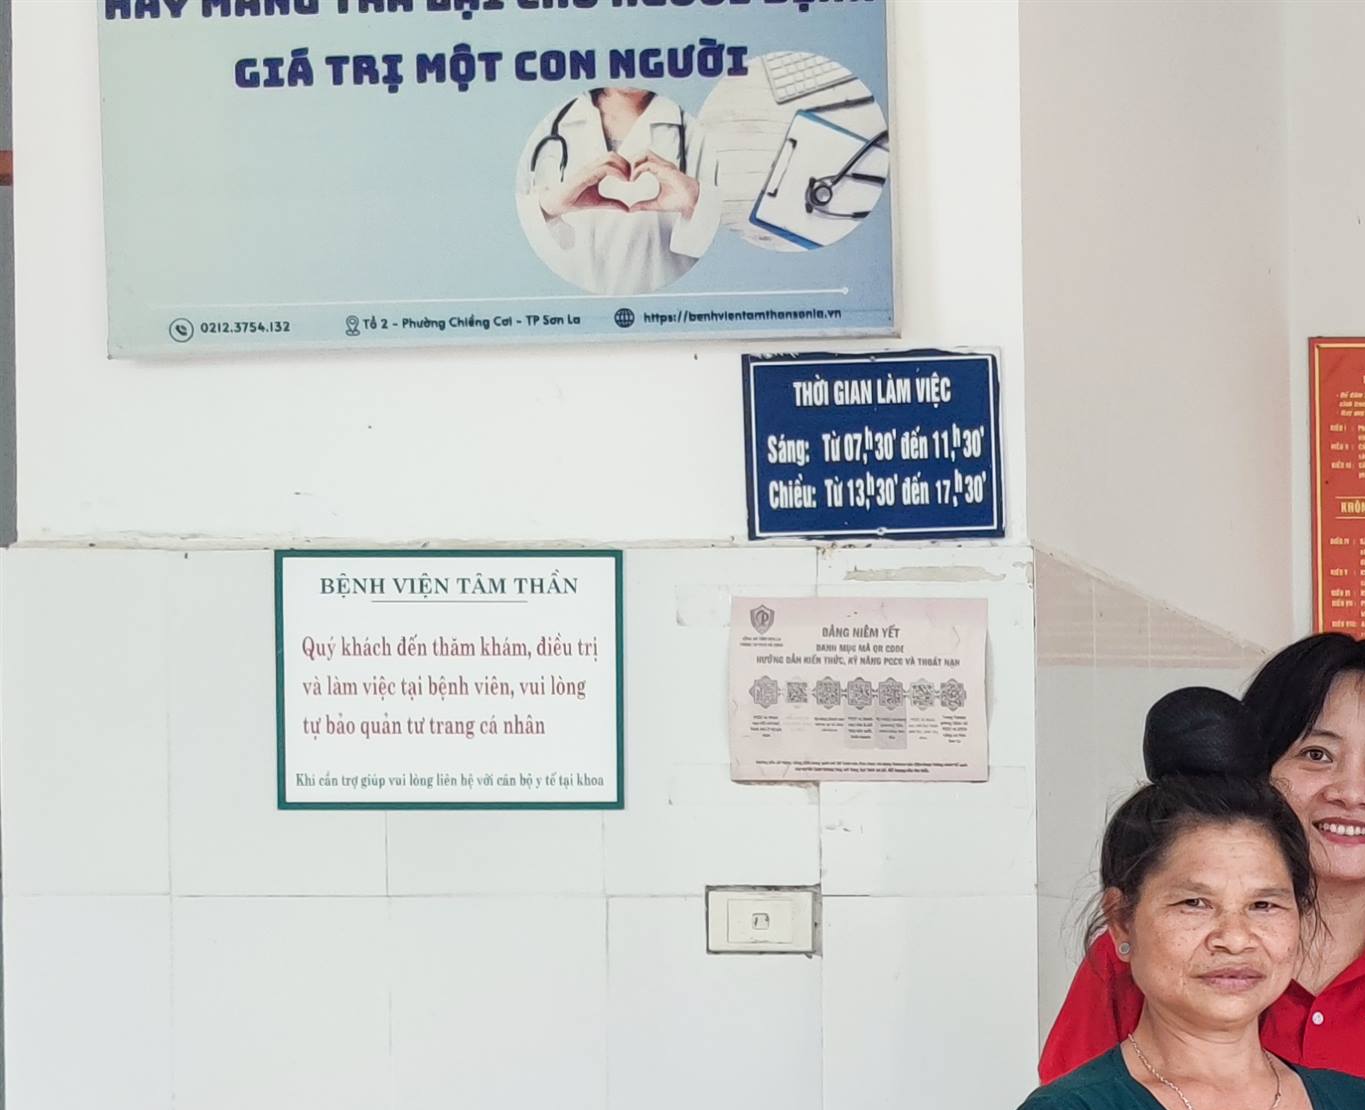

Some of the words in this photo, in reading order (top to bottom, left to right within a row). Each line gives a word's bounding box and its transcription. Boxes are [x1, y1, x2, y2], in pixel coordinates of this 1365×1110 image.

[235, 47, 313, 88] GIÁ
[325, 54, 403, 93] TRỊ
[416, 42, 502, 92] MỘT
[515, 49, 596, 81] CON
[609, 38, 748, 79] NGƯỜI
[200, 320, 291, 334] 0212.3754.132
[381, 318, 389, 329] 2
[402, 315, 446, 332] Phường
[526, 315, 540, 327] TP
[542, 314, 565, 327] Sơn
[567, 313, 581, 325] La
[793, 374, 829, 407] THỜI
[834, 378, 873, 406] GIAN
[877, 373, 911, 405] LÀM
[916, 371, 951, 408] VIỆC
[768, 429, 810, 466] Sáng:
[822, 428, 840, 462] Từ
[901, 426, 929, 460] đến
[769, 473, 817, 509] Chiều:
[825, 475, 843, 507] Từ
[902, 472, 929, 505] đến
[320, 573, 385, 598] BỆNH
[393, 573, 449, 598] VIỆN
[457, 573, 506, 595] TÂM
[514, 569, 579, 595] THẦN
[822, 624, 850, 639] BẢNG
[852, 624, 879, 639] NIÊM
[882, 623, 901, 639] YẾT
[302, 635, 336, 661] Quý
[341, 636, 392, 657] khách
[397, 634, 427, 657] đến
[432, 637, 476, 657] thăm
[480, 636, 532, 660] khám,
[536, 632, 573, 657] điều
[577, 636, 599, 662] trị
[303, 676, 322, 696] và
[327, 675, 358, 696] làm
[363, 676, 396, 701] việc
[401, 676, 423, 701] tại
[428, 675, 469, 701] bệnh
[519, 677, 546, 696] vui
[550, 675, 587, 700] lòng
[303, 716, 322, 741] tự
[326, 712, 356, 736] bảo
[360, 712, 402, 740] quản
[407, 715, 426, 736] tư
[430, 716, 475, 739] trang
[479, 715, 498, 736] cá
[503, 714, 546, 736] nhân
[296, 773, 316, 787] Khi
[318, 770, 339, 787] cần
[341, 773, 360, 789] trợ
[360, 772, 386, 789] giúp
[388, 773, 407, 787] vui
[409, 773, 433, 789] lòng
[436, 773, 458, 787] liên
[460, 773, 474, 789] hệ
[476, 772, 494, 787] với
[496, 772, 517, 787] cán
[519, 773, 534, 789] bộ
[535, 777, 543, 789] y
[545, 770, 557, 787] tế
[559, 773, 574, 789] tại
[576, 773, 605, 787] khoa
